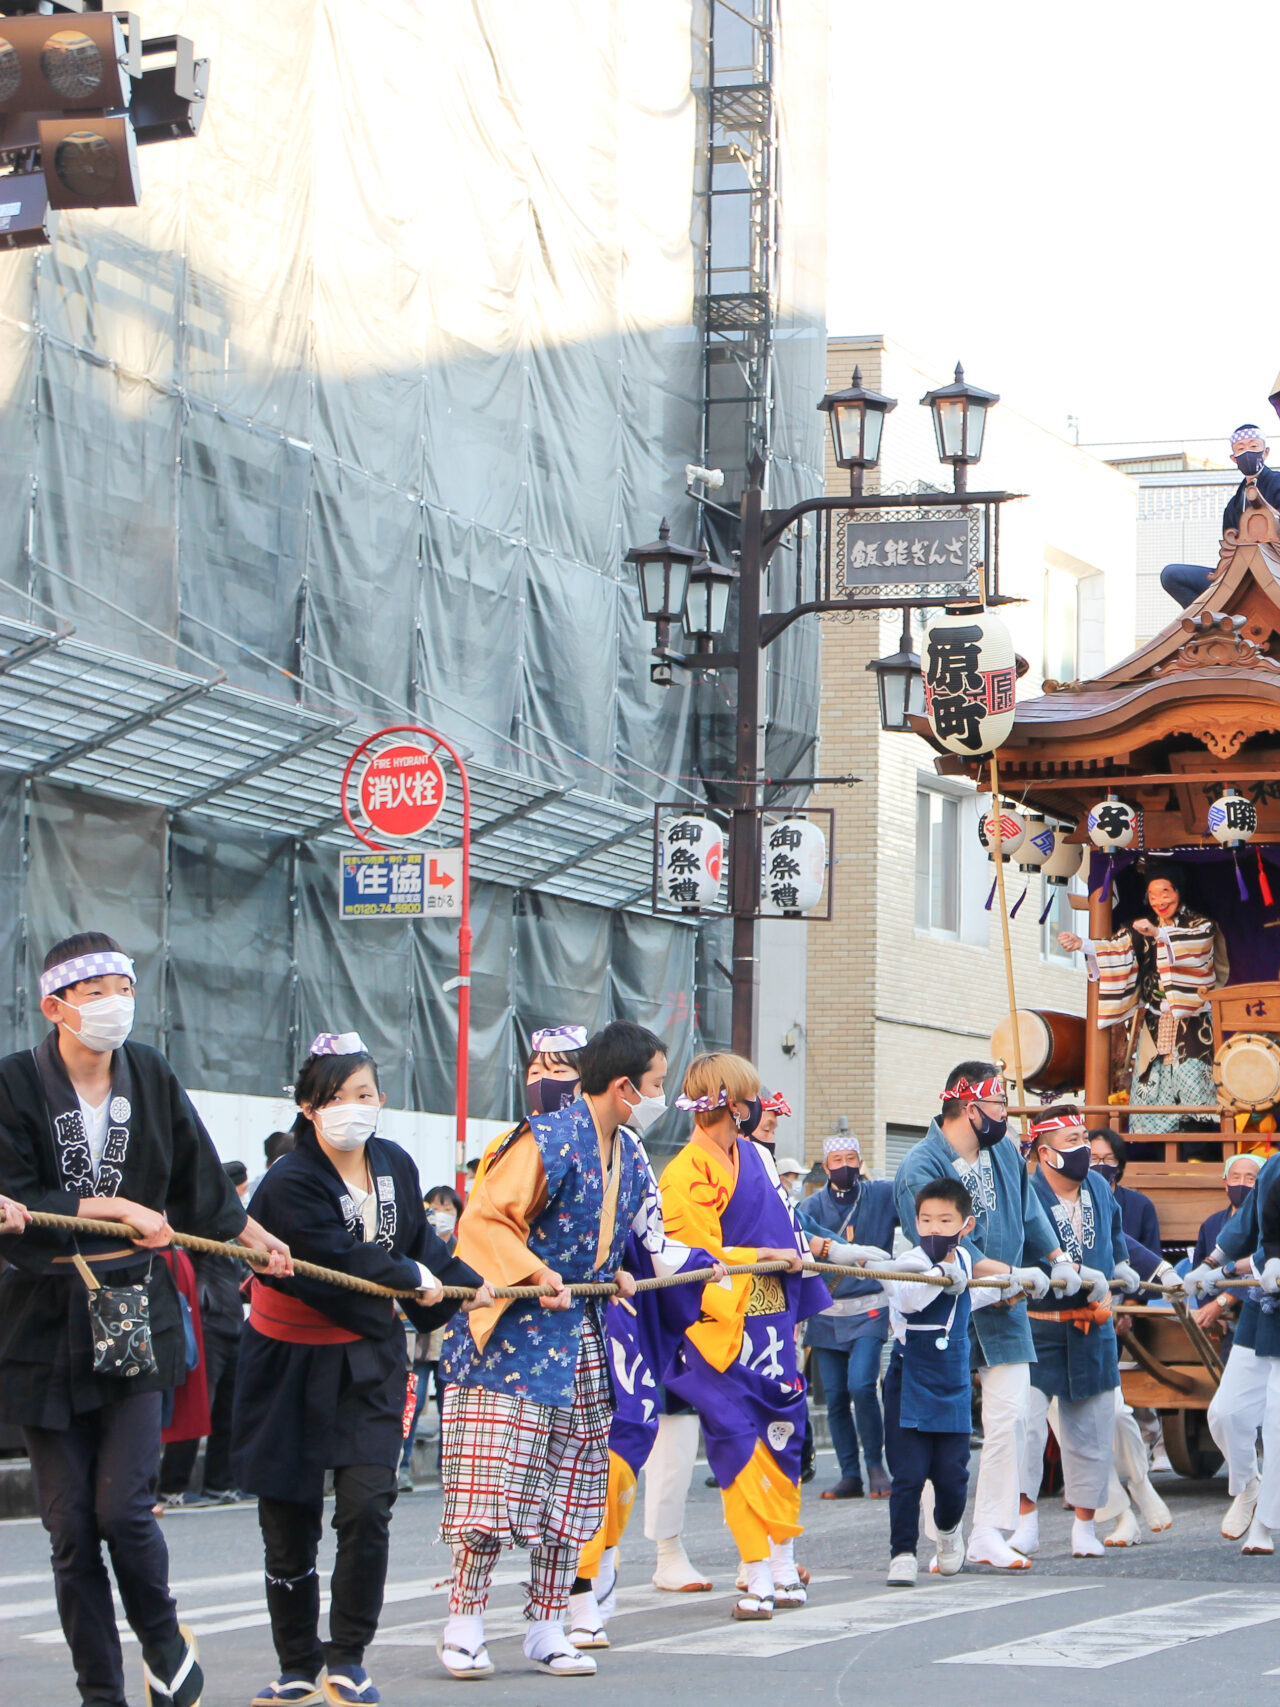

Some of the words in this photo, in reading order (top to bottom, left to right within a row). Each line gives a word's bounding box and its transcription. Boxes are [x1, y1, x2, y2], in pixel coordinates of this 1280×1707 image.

[851, 535, 967, 569] 飯能ぎんざ
[926, 624, 988, 750] 原町
[374, 759, 391, 770] FIRE
[393, 755, 430, 769] HYDRANT
[367, 770, 438, 811] 消火栓
[356, 864, 422, 895] 住協
[667, 821, 703, 903] 御祭禮
[769, 825, 802, 908] 御祭禮
[427, 895, 455, 909] 曲がる
[93, 1127, 130, 1200] 原町
[981, 1166, 997, 1212] 原町
[1081, 1205, 1096, 1250] 原町
